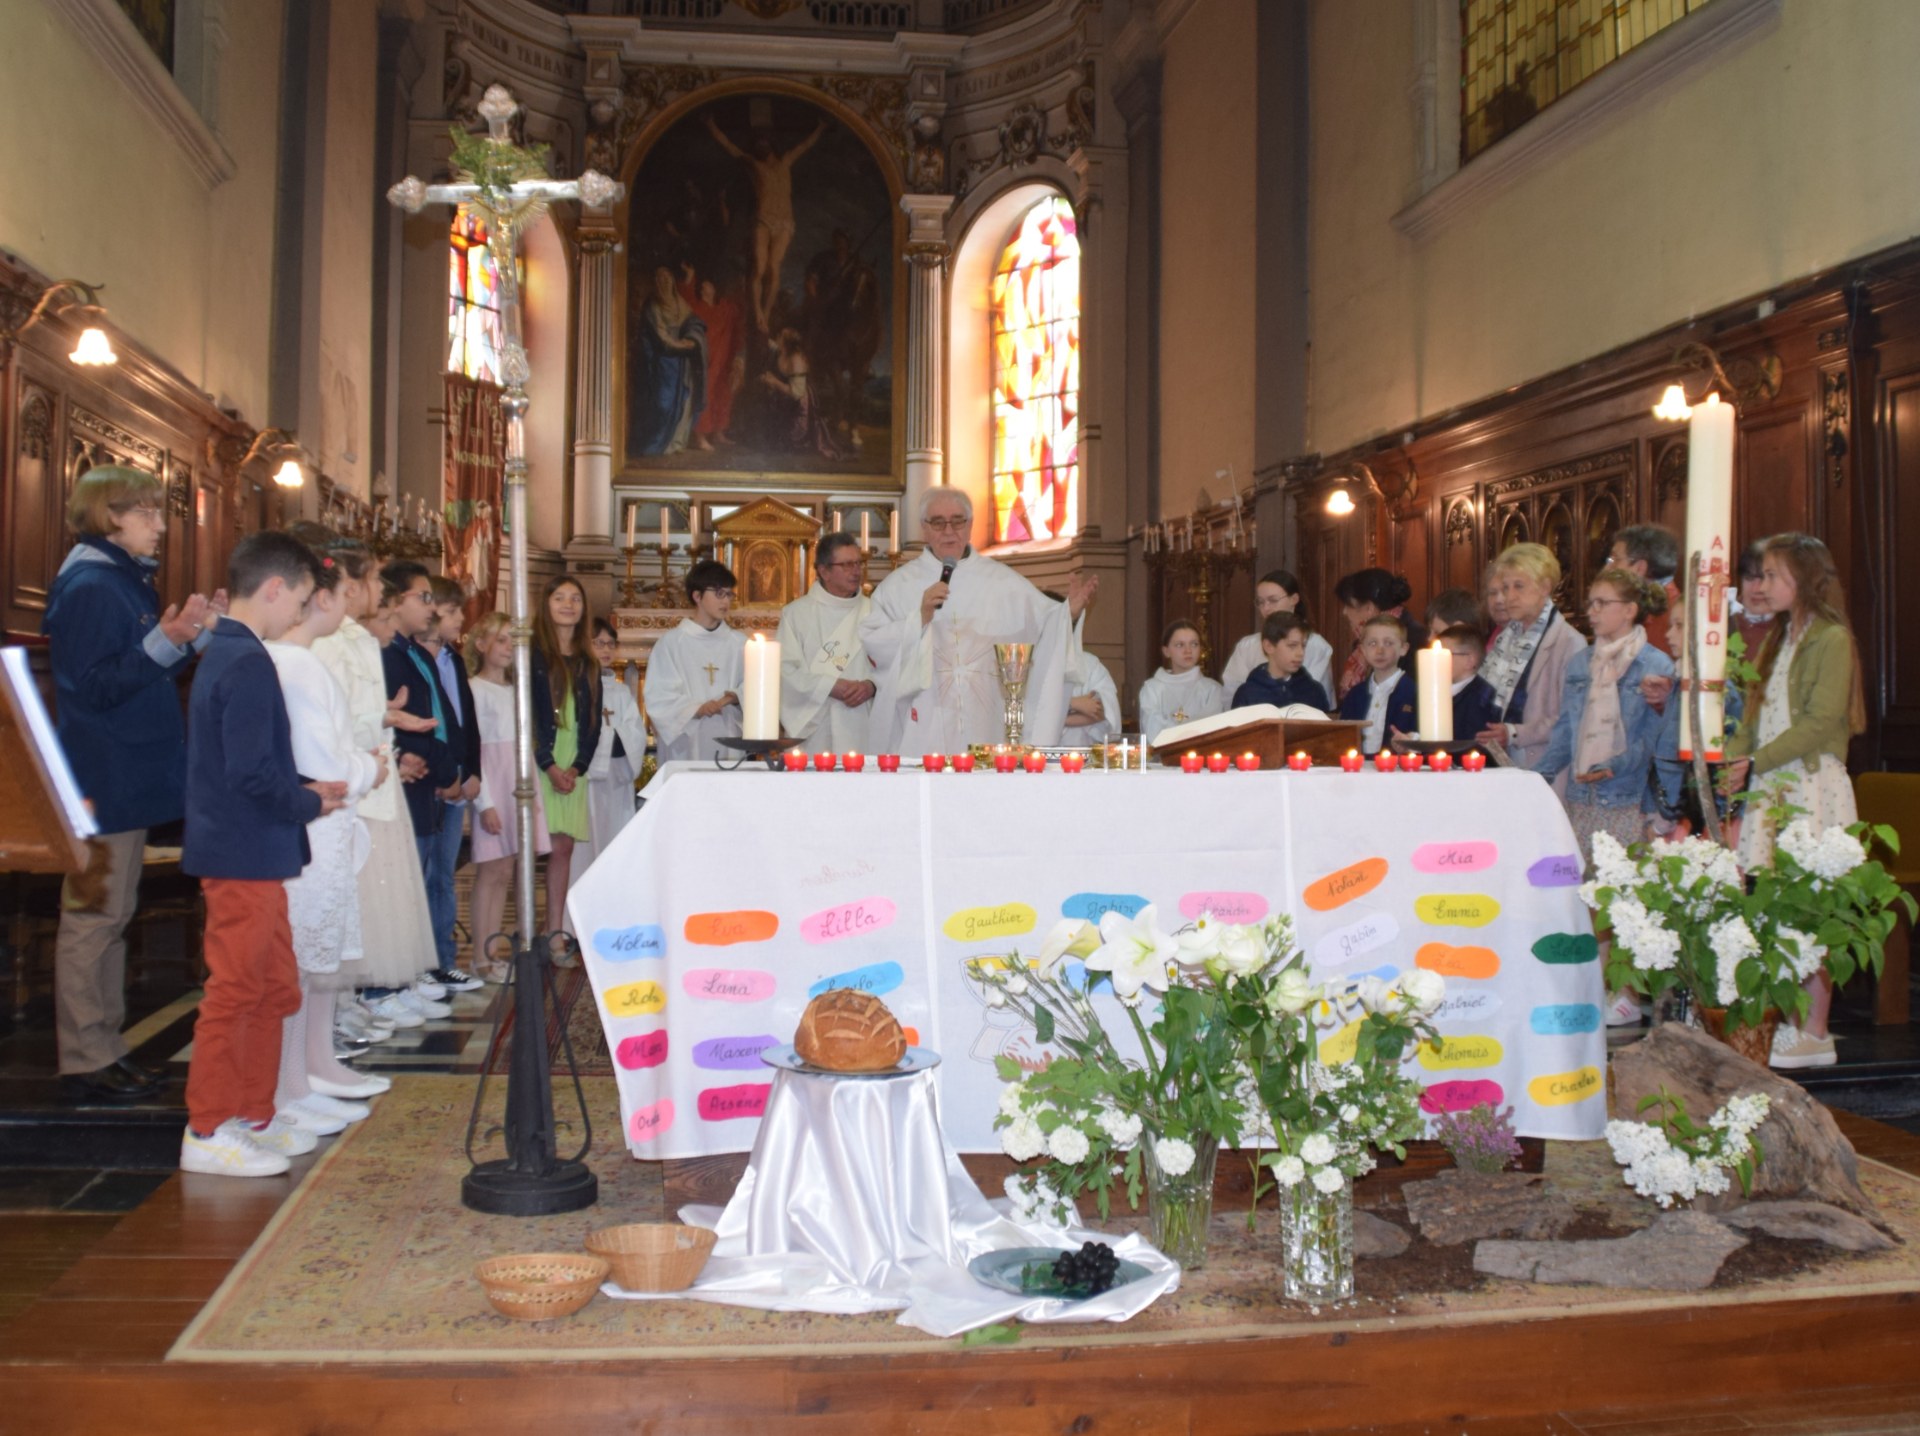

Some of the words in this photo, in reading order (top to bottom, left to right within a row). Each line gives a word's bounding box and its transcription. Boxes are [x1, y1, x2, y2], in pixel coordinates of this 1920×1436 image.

[1433, 899, 1481, 920] Emma
[702, 972, 751, 997] Lana
[1550, 1072, 1597, 1096] Charles
